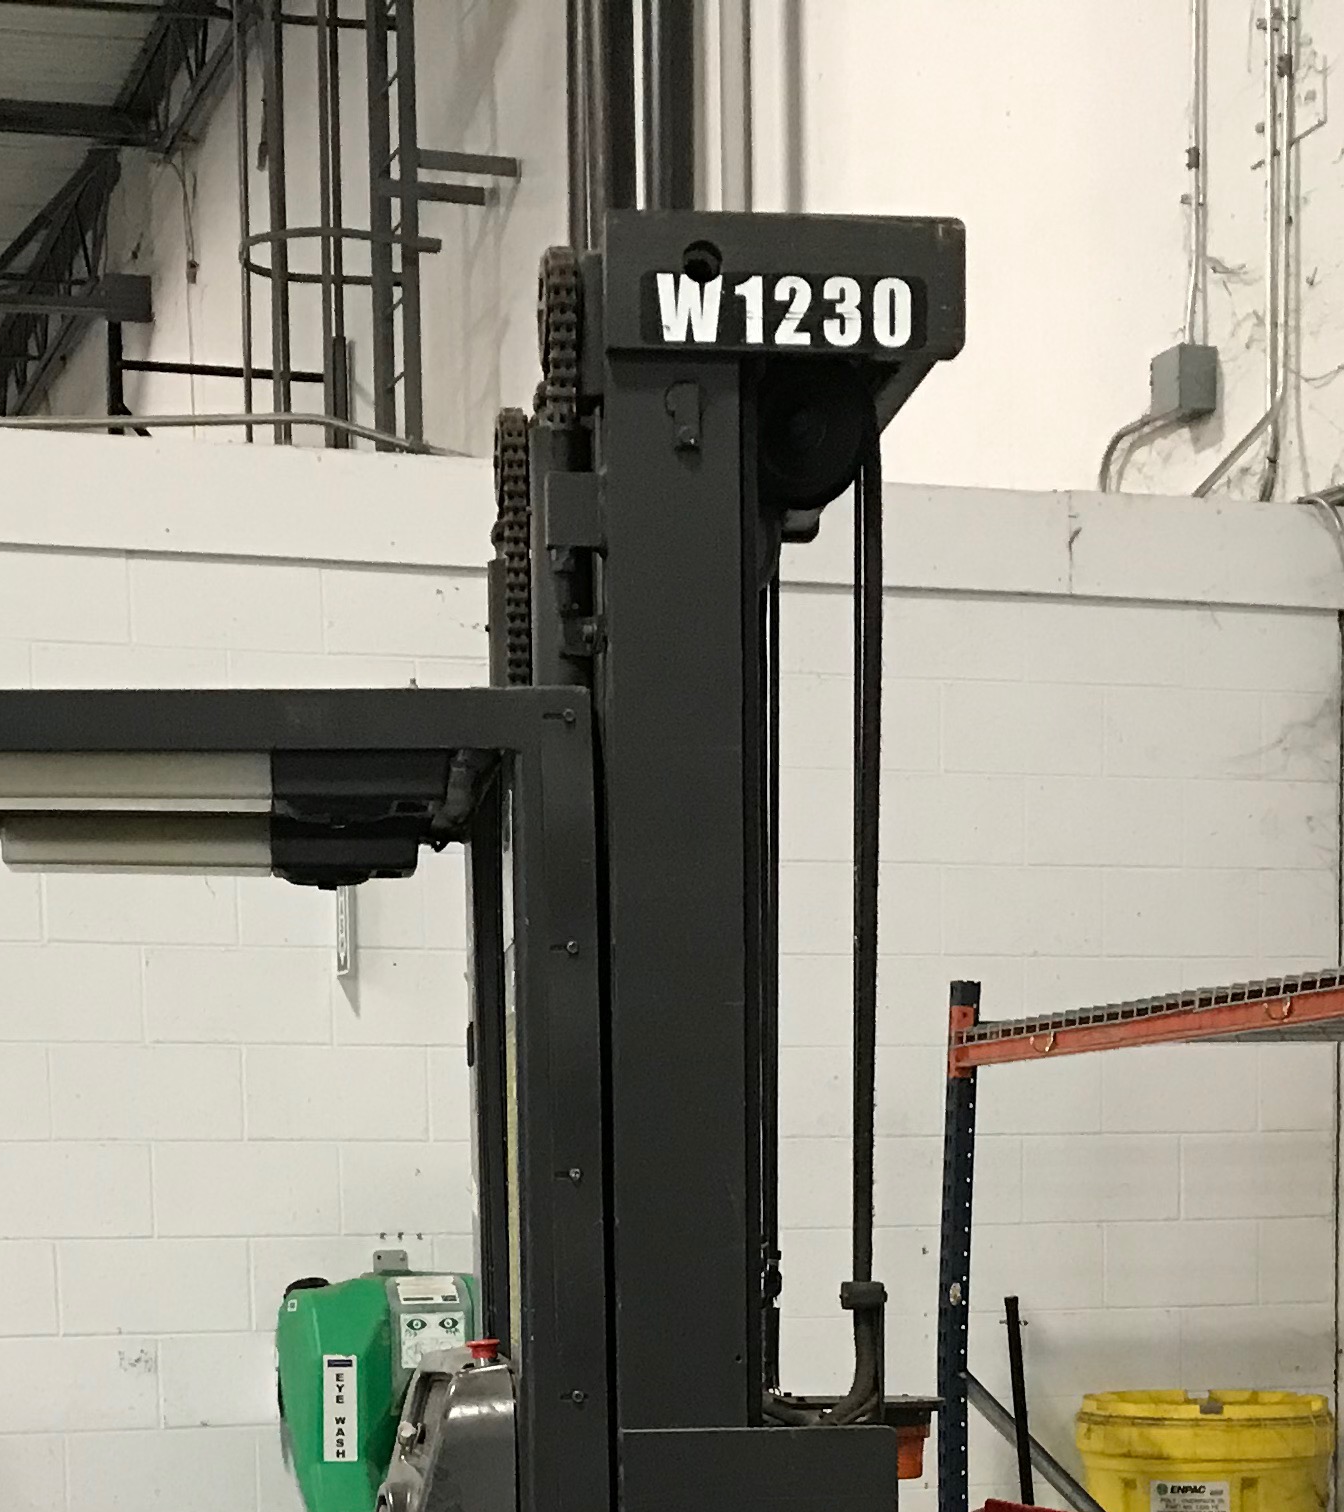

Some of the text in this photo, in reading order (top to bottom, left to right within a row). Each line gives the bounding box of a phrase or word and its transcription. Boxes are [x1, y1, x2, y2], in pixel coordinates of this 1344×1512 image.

[656, 272, 912, 348] W1230
[335, 1372, 345, 1404] EYE
[334, 1416, 346, 1459] WASH
